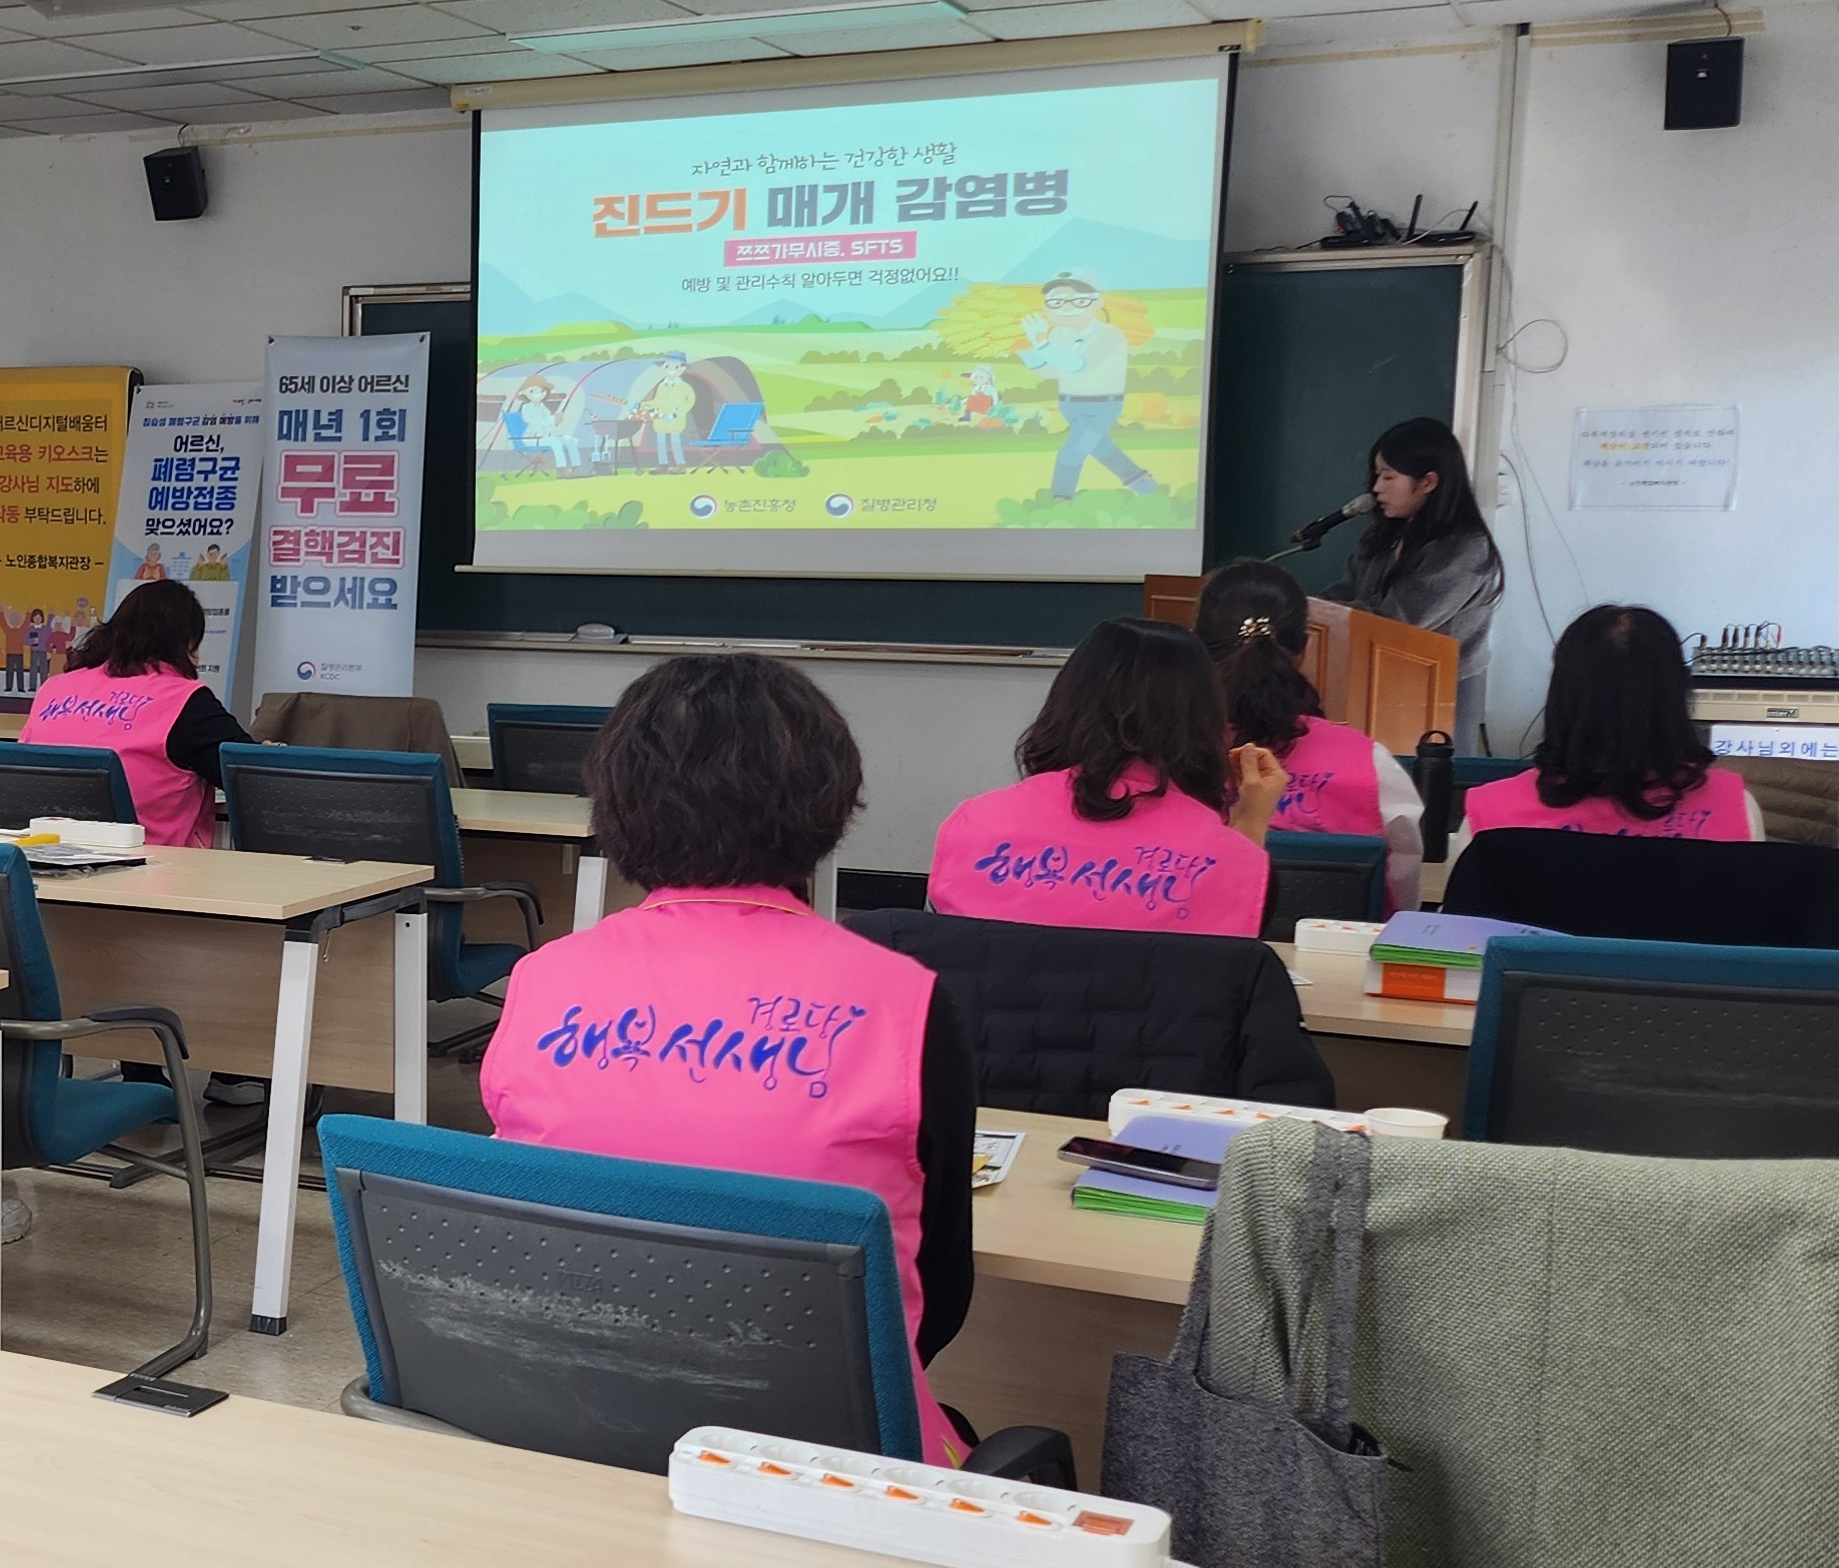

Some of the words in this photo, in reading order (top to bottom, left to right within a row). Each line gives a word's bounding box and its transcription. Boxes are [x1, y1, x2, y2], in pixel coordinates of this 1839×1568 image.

[691, 156, 752, 176] 자연과
[756, 152, 839, 174] 함께하는
[844, 146, 908, 169] 건강한
[913, 142, 957, 165] 생활
[593, 188, 747, 238] 진드기
[767, 180, 875, 229] 매개
[895, 169, 1069, 223] 감염병
[736, 240, 845, 262] 쯔쯔가무시증,
[851, 239, 903, 256] SFTS
[681, 276, 711, 293] 예방
[716, 275, 731, 291] 및
[736, 271, 795, 290] 관리수칙
[801, 269, 862, 288] 알아두면
[868, 266, 959, 286] 걱정없어요!!
[279, 375, 316, 394] 65세
[320, 375, 354, 394] 이상
[358, 374, 410, 393] 어르신
[277, 408, 343, 442] 매년
[360, 407, 407, 442] 1회
[38, 444, 108, 463] 키오스크는
[173, 434, 224, 454] 어르신,
[151, 456, 241, 483] 폐렴구균
[0, 475, 39, 493] 강사님
[46, 476, 99, 494] 지도하에
[278, 453, 398, 515] 무료
[148, 485, 237, 511] 예방접종
[860, 497, 938, 513] 질병관리청
[24, 507, 106, 525] 부탁드립니다.
[145, 518, 234, 536] 맞으셨어요?
[270, 528, 402, 566] 결핵검진
[5, 554, 91, 570] 노인종합복지관장
[269, 574, 398, 610] 받으세요
[748, 996, 841, 1039] 경로당
